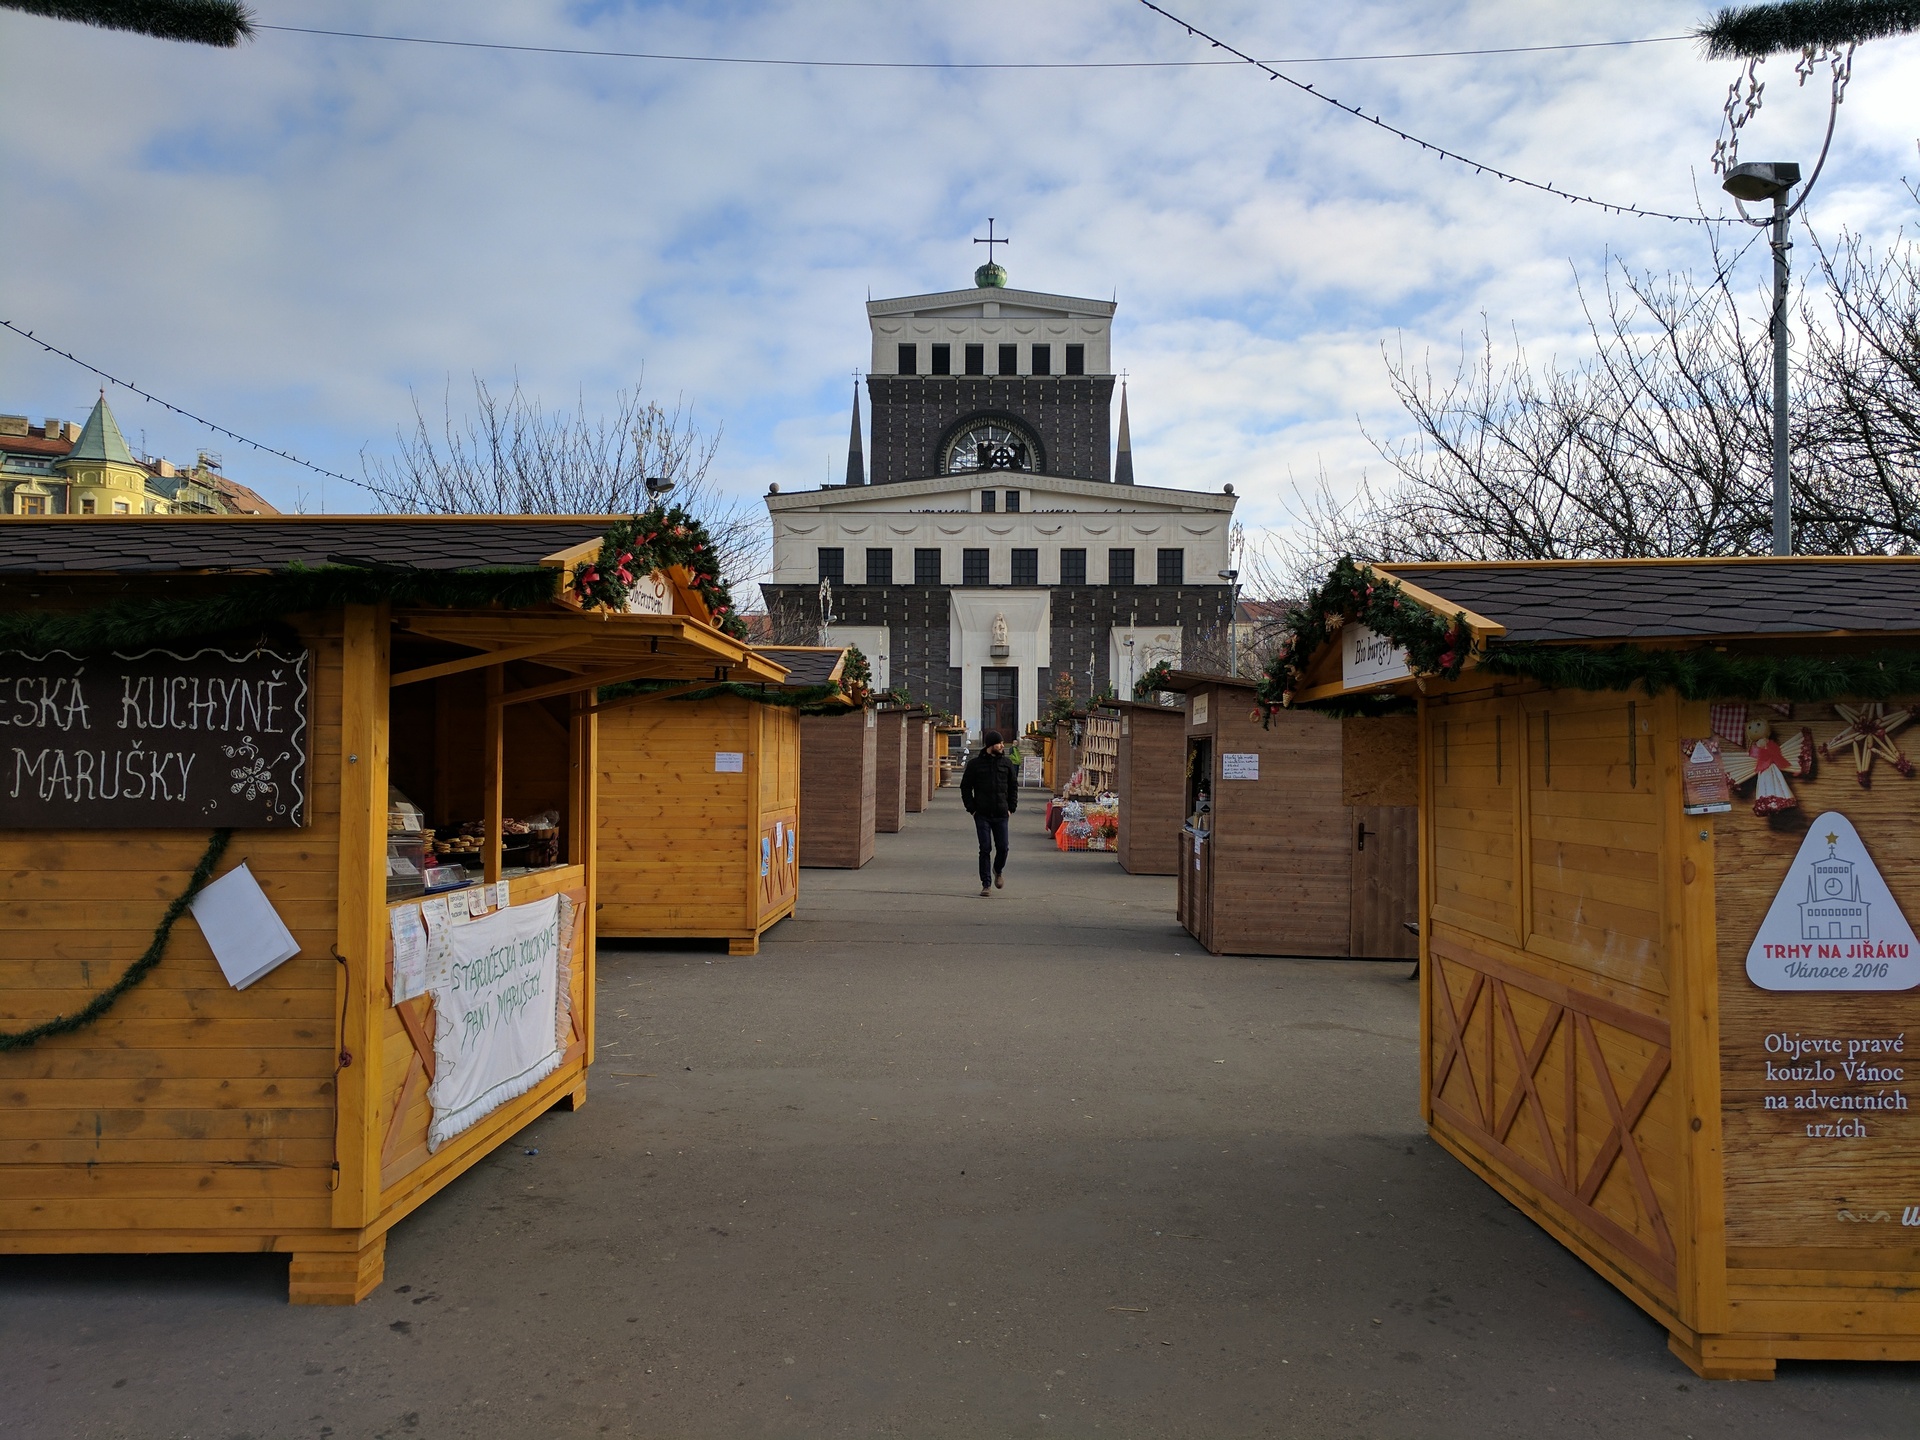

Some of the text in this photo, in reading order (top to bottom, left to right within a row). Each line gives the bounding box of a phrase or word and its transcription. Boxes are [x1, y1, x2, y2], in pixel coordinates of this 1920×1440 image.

[1354, 638, 1367, 665] Bio
[117, 669, 288, 733] KUCHYNĚ
[10, 740, 196, 802] MARUŠKY
[1763, 940, 1909, 959] TRHY NA JIŘÁKU
[1784, 961, 1889, 978] Vánoce 2016
[1764, 1032, 1905, 1060] Objevte pravé
[1765, 1060, 1904, 1081] kouzlo Vánoc
[1764, 1089, 1909, 1110] na adventních
[1806, 1117, 1867, 1138] trzích
